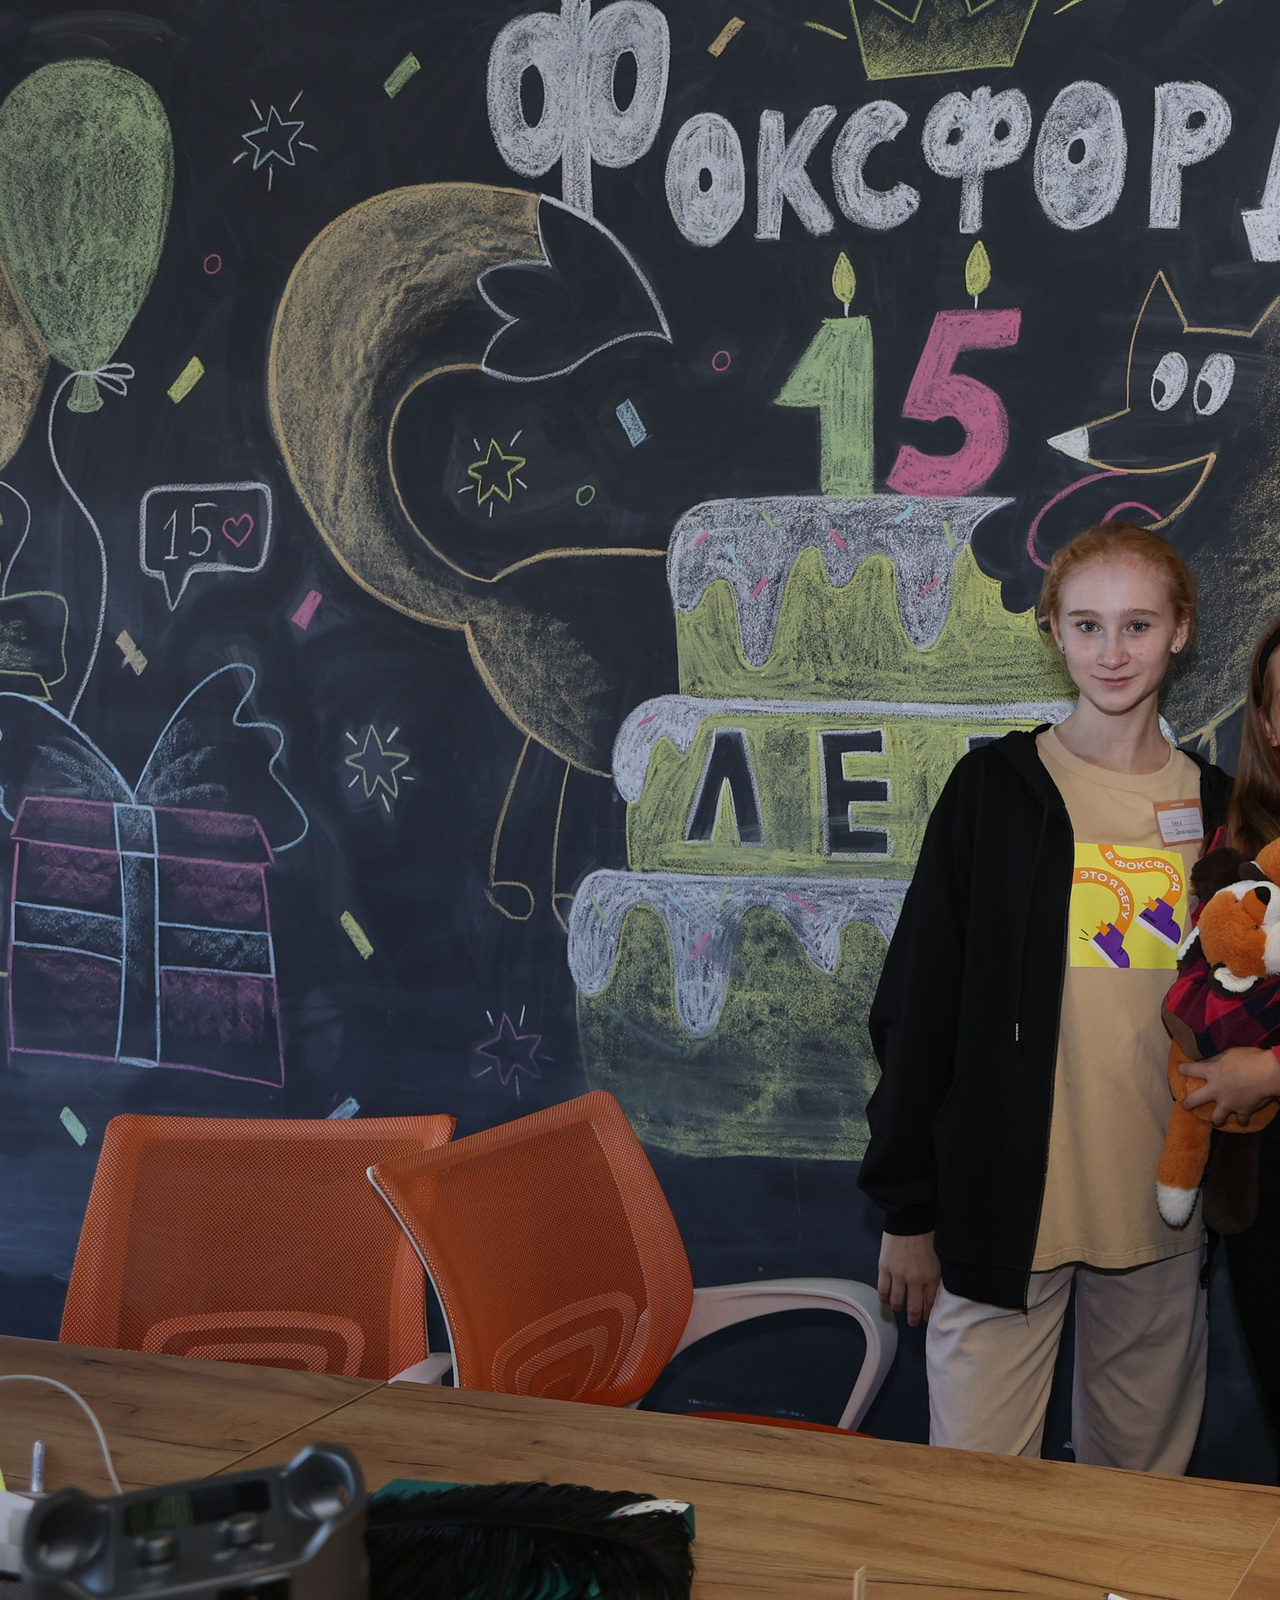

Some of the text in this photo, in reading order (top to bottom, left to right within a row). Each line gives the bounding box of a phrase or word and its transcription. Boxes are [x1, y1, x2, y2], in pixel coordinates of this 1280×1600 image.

[773, 308, 1022, 498] 15
[163, 502, 219, 560] 15
[683, 725, 1006, 859] ЛЕ
[1080, 870, 1130, 921] ЭТО Я БЕГУ
[1104, 850, 1181, 892] В ФОКСФОРД
